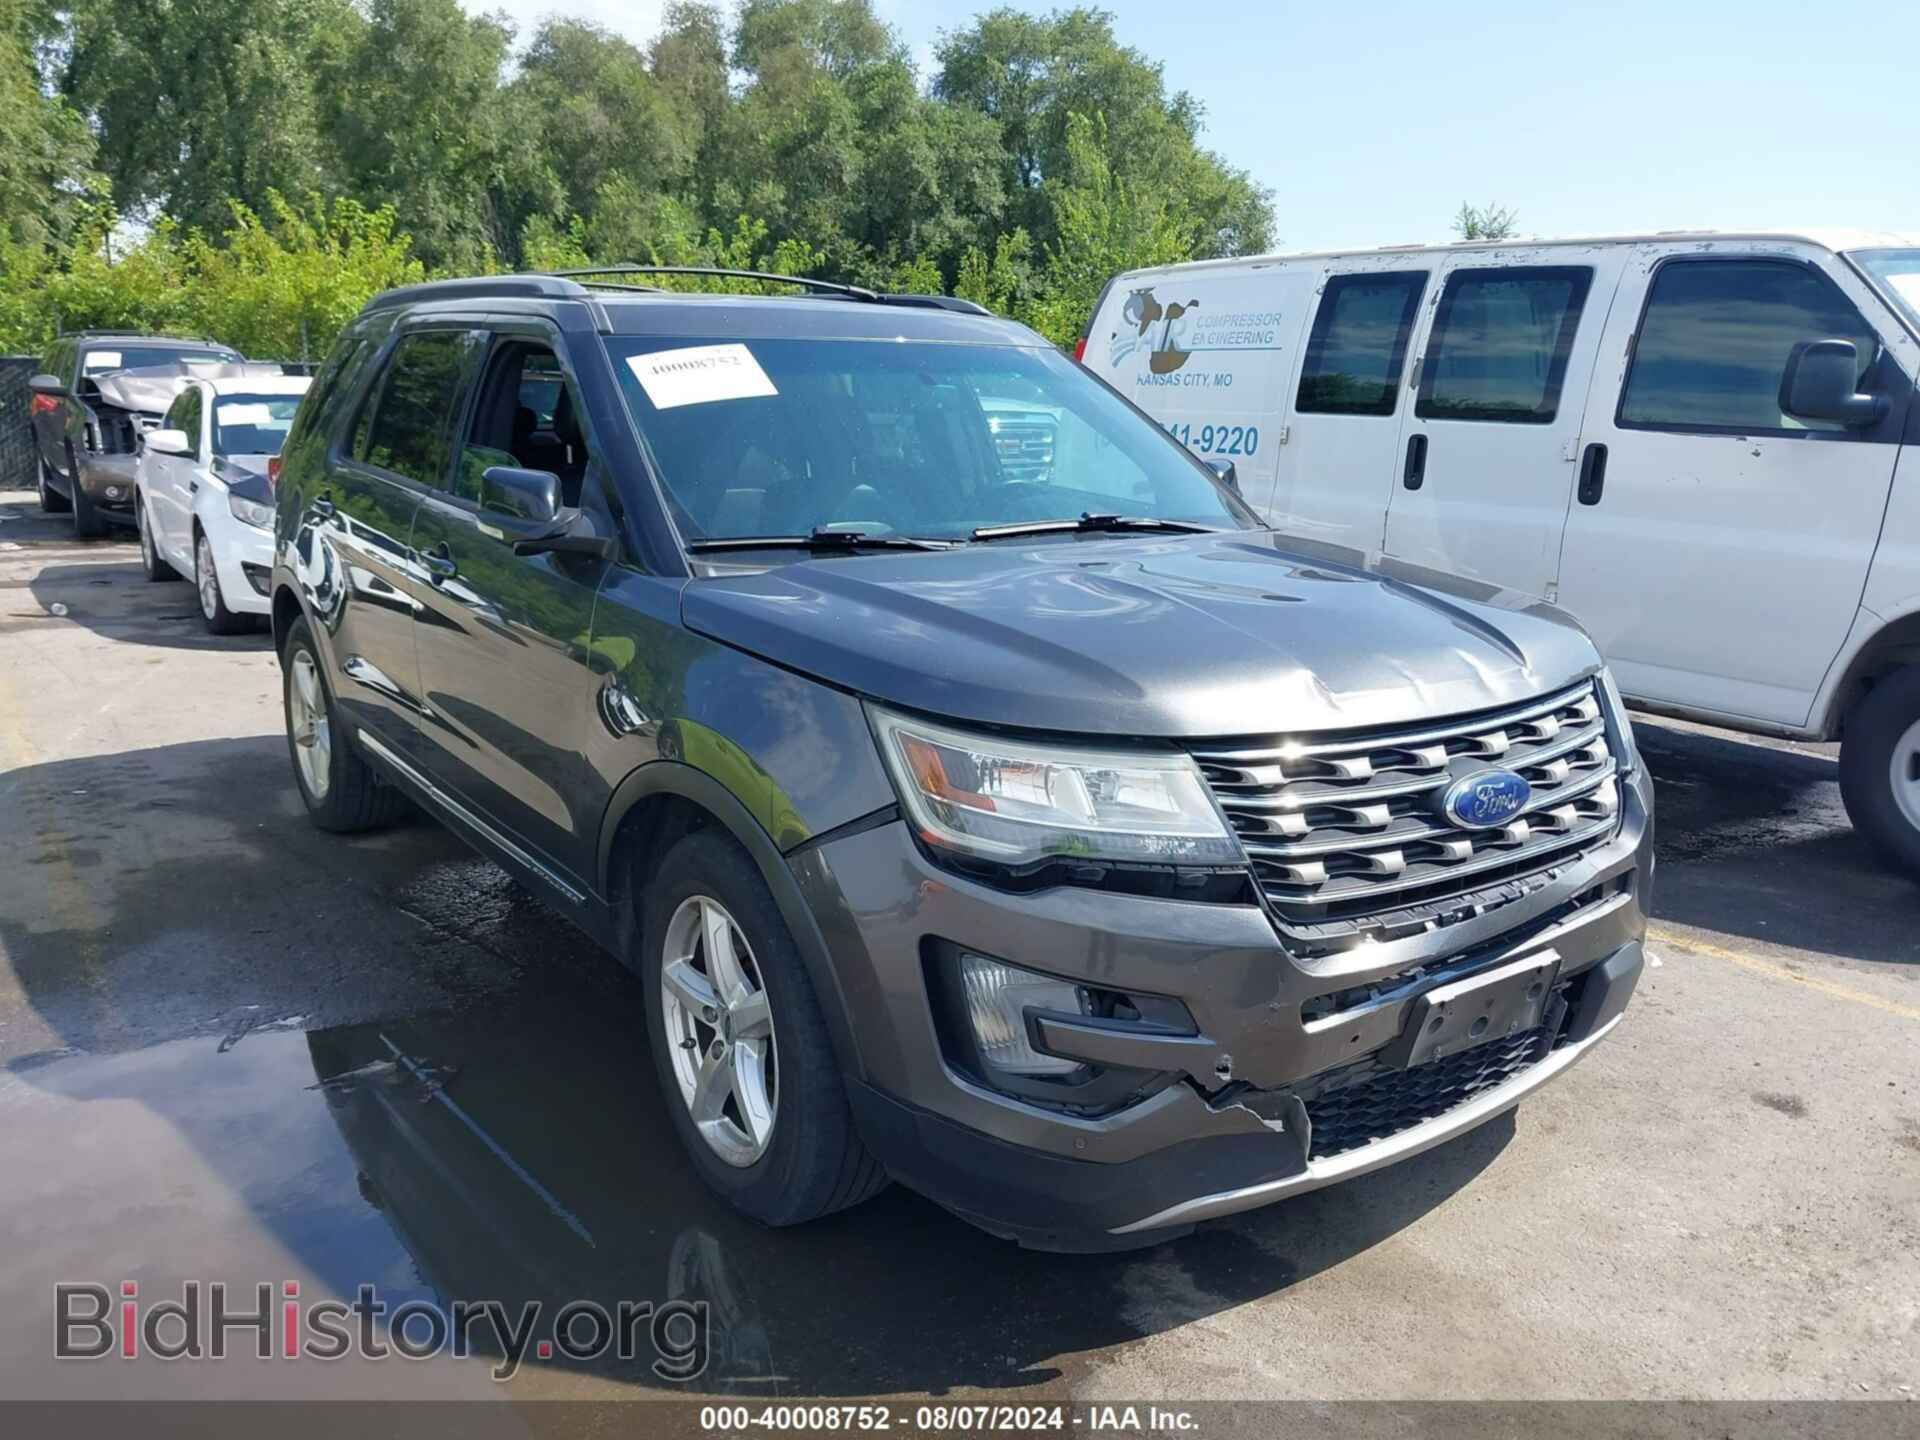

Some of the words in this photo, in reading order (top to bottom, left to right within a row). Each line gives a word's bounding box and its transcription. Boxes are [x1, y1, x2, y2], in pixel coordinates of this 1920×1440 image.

[1196, 312, 1282, 328] COMPRESSOR
[1136, 373, 1182, 387] KANSAS
[1184, 373, 1210, 389] CITY,
[1213, 373, 1233, 387] MO
[1475, 782, 1519, 818] Ford
